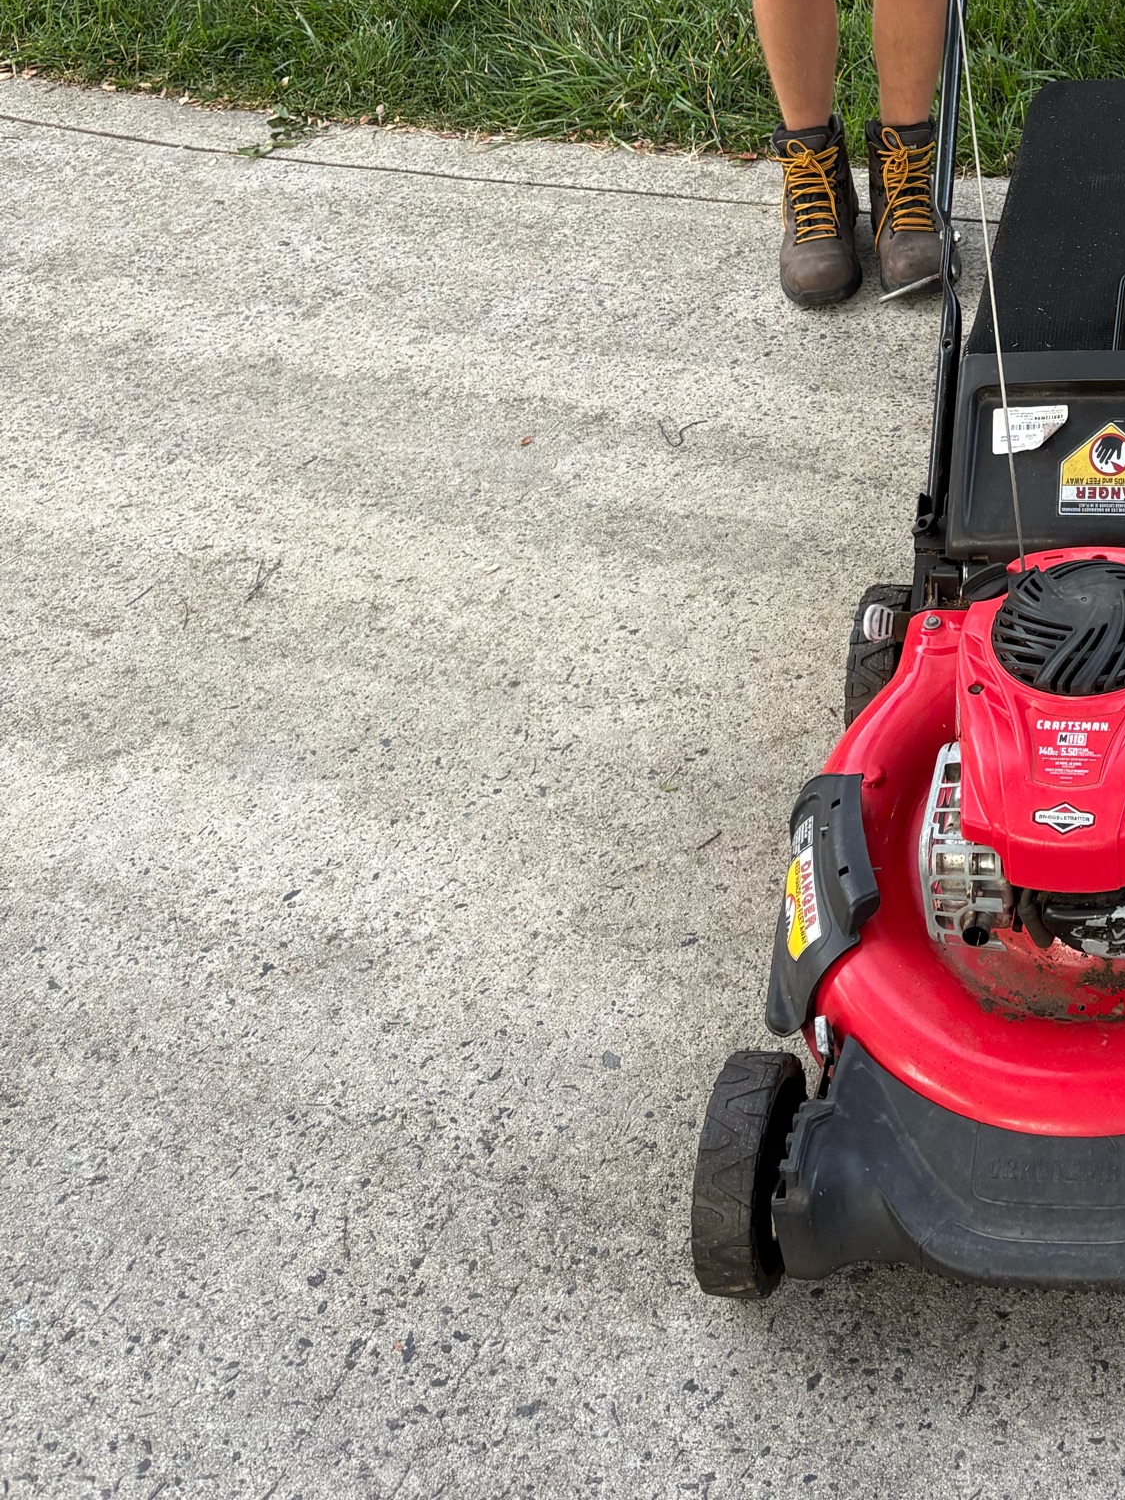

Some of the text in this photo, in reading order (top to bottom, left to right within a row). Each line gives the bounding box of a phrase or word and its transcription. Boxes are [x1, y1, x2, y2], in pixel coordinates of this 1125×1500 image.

[1066, 477, 1084, 485] AWAY
[1085, 477, 1101, 485] FEET
[1036, 719, 1109, 731] CRAFTSMAN
[801, 860, 816, 929] DANGER
